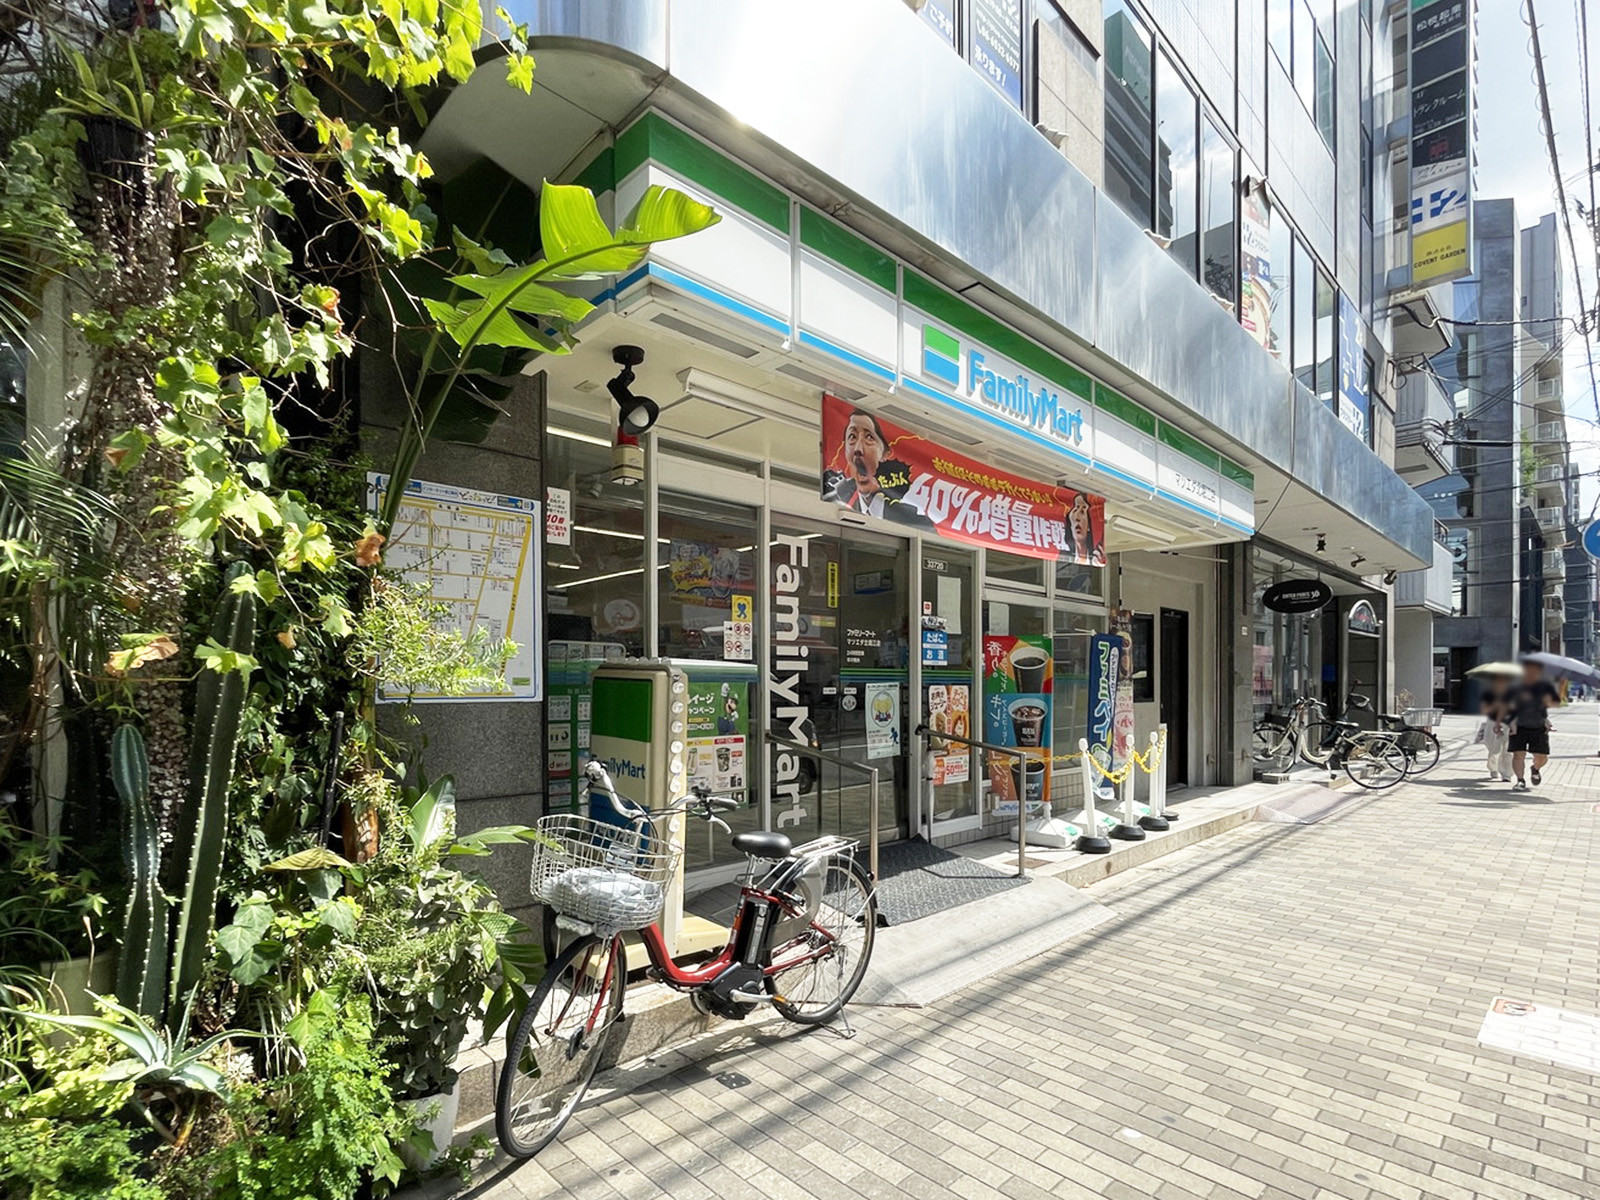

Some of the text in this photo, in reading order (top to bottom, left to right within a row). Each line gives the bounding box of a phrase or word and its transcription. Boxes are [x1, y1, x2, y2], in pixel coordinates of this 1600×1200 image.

[1413, 248, 1466, 269] COVENT GARDEN
[967, 349, 1084, 446] FamilyMart
[901, 472, 1071, 551] 40%増量作戦
[926, 560, 944, 570] 33720
[926, 632, 944, 643] たばこ
[770, 533, 809, 829] FamilyMart
[1094, 641, 1112, 742] ファミペイ
